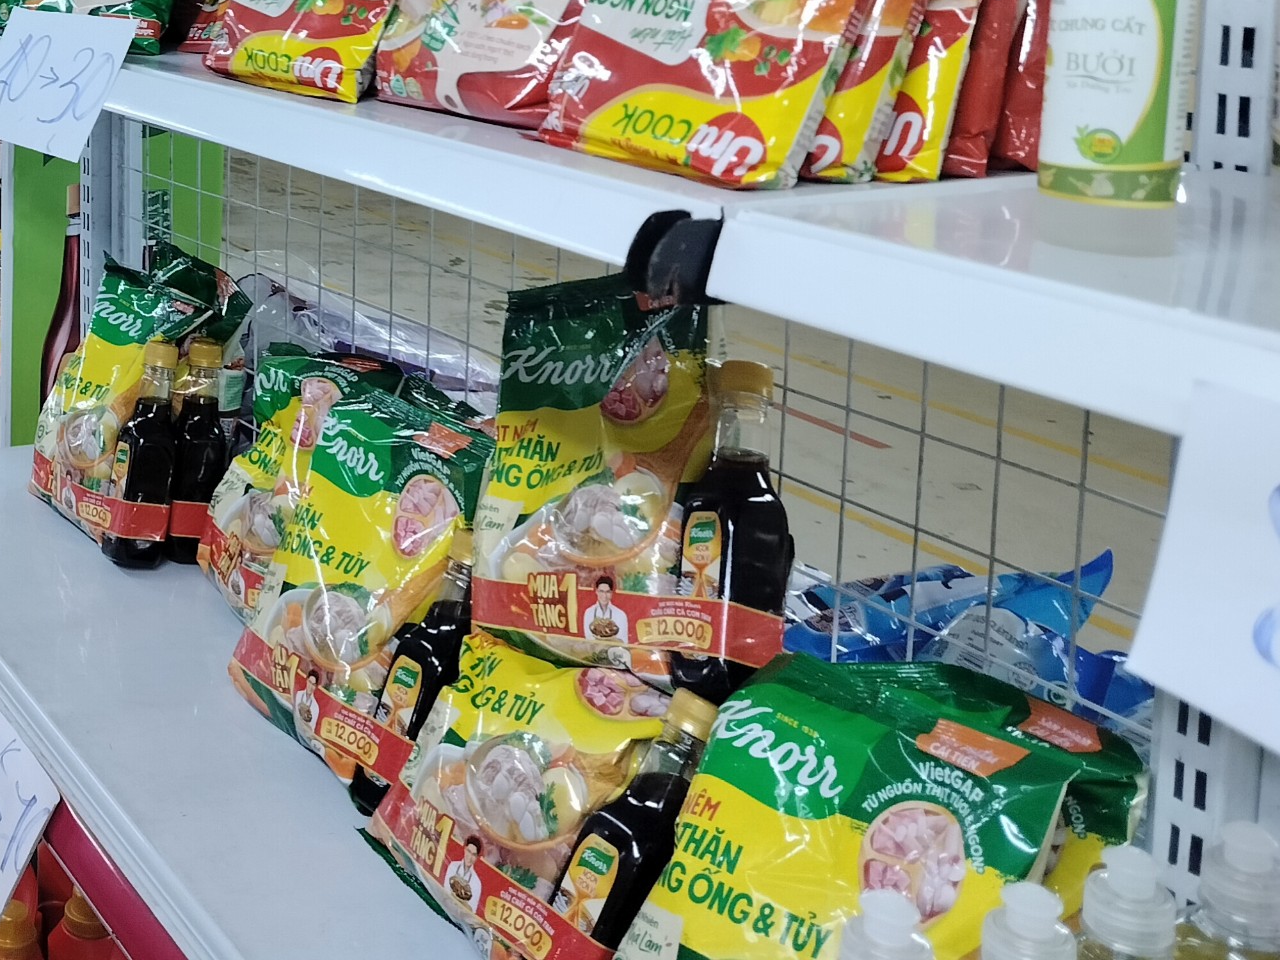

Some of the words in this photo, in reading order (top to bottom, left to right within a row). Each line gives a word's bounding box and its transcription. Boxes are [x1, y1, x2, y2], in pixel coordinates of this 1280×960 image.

[501, 346, 617, 385] Knorr
[293, 502, 324, 531] HĂN
[320, 545, 336, 566] &
[335, 551, 371, 578] TỦY
[528, 573, 560, 599] MUA
[529, 598, 567, 633] TẶNG
[491, 689, 509, 715] &
[506, 691, 546, 726] TỦY
[709, 699, 845, 798] Knorr
[861, 794, 880, 813] TỪ
[877, 777, 924, 802] NGUỒN
[919, 761, 985, 804] VietGAP
[753, 903, 776, 937] &
[779, 910, 834, 960] TỦY
